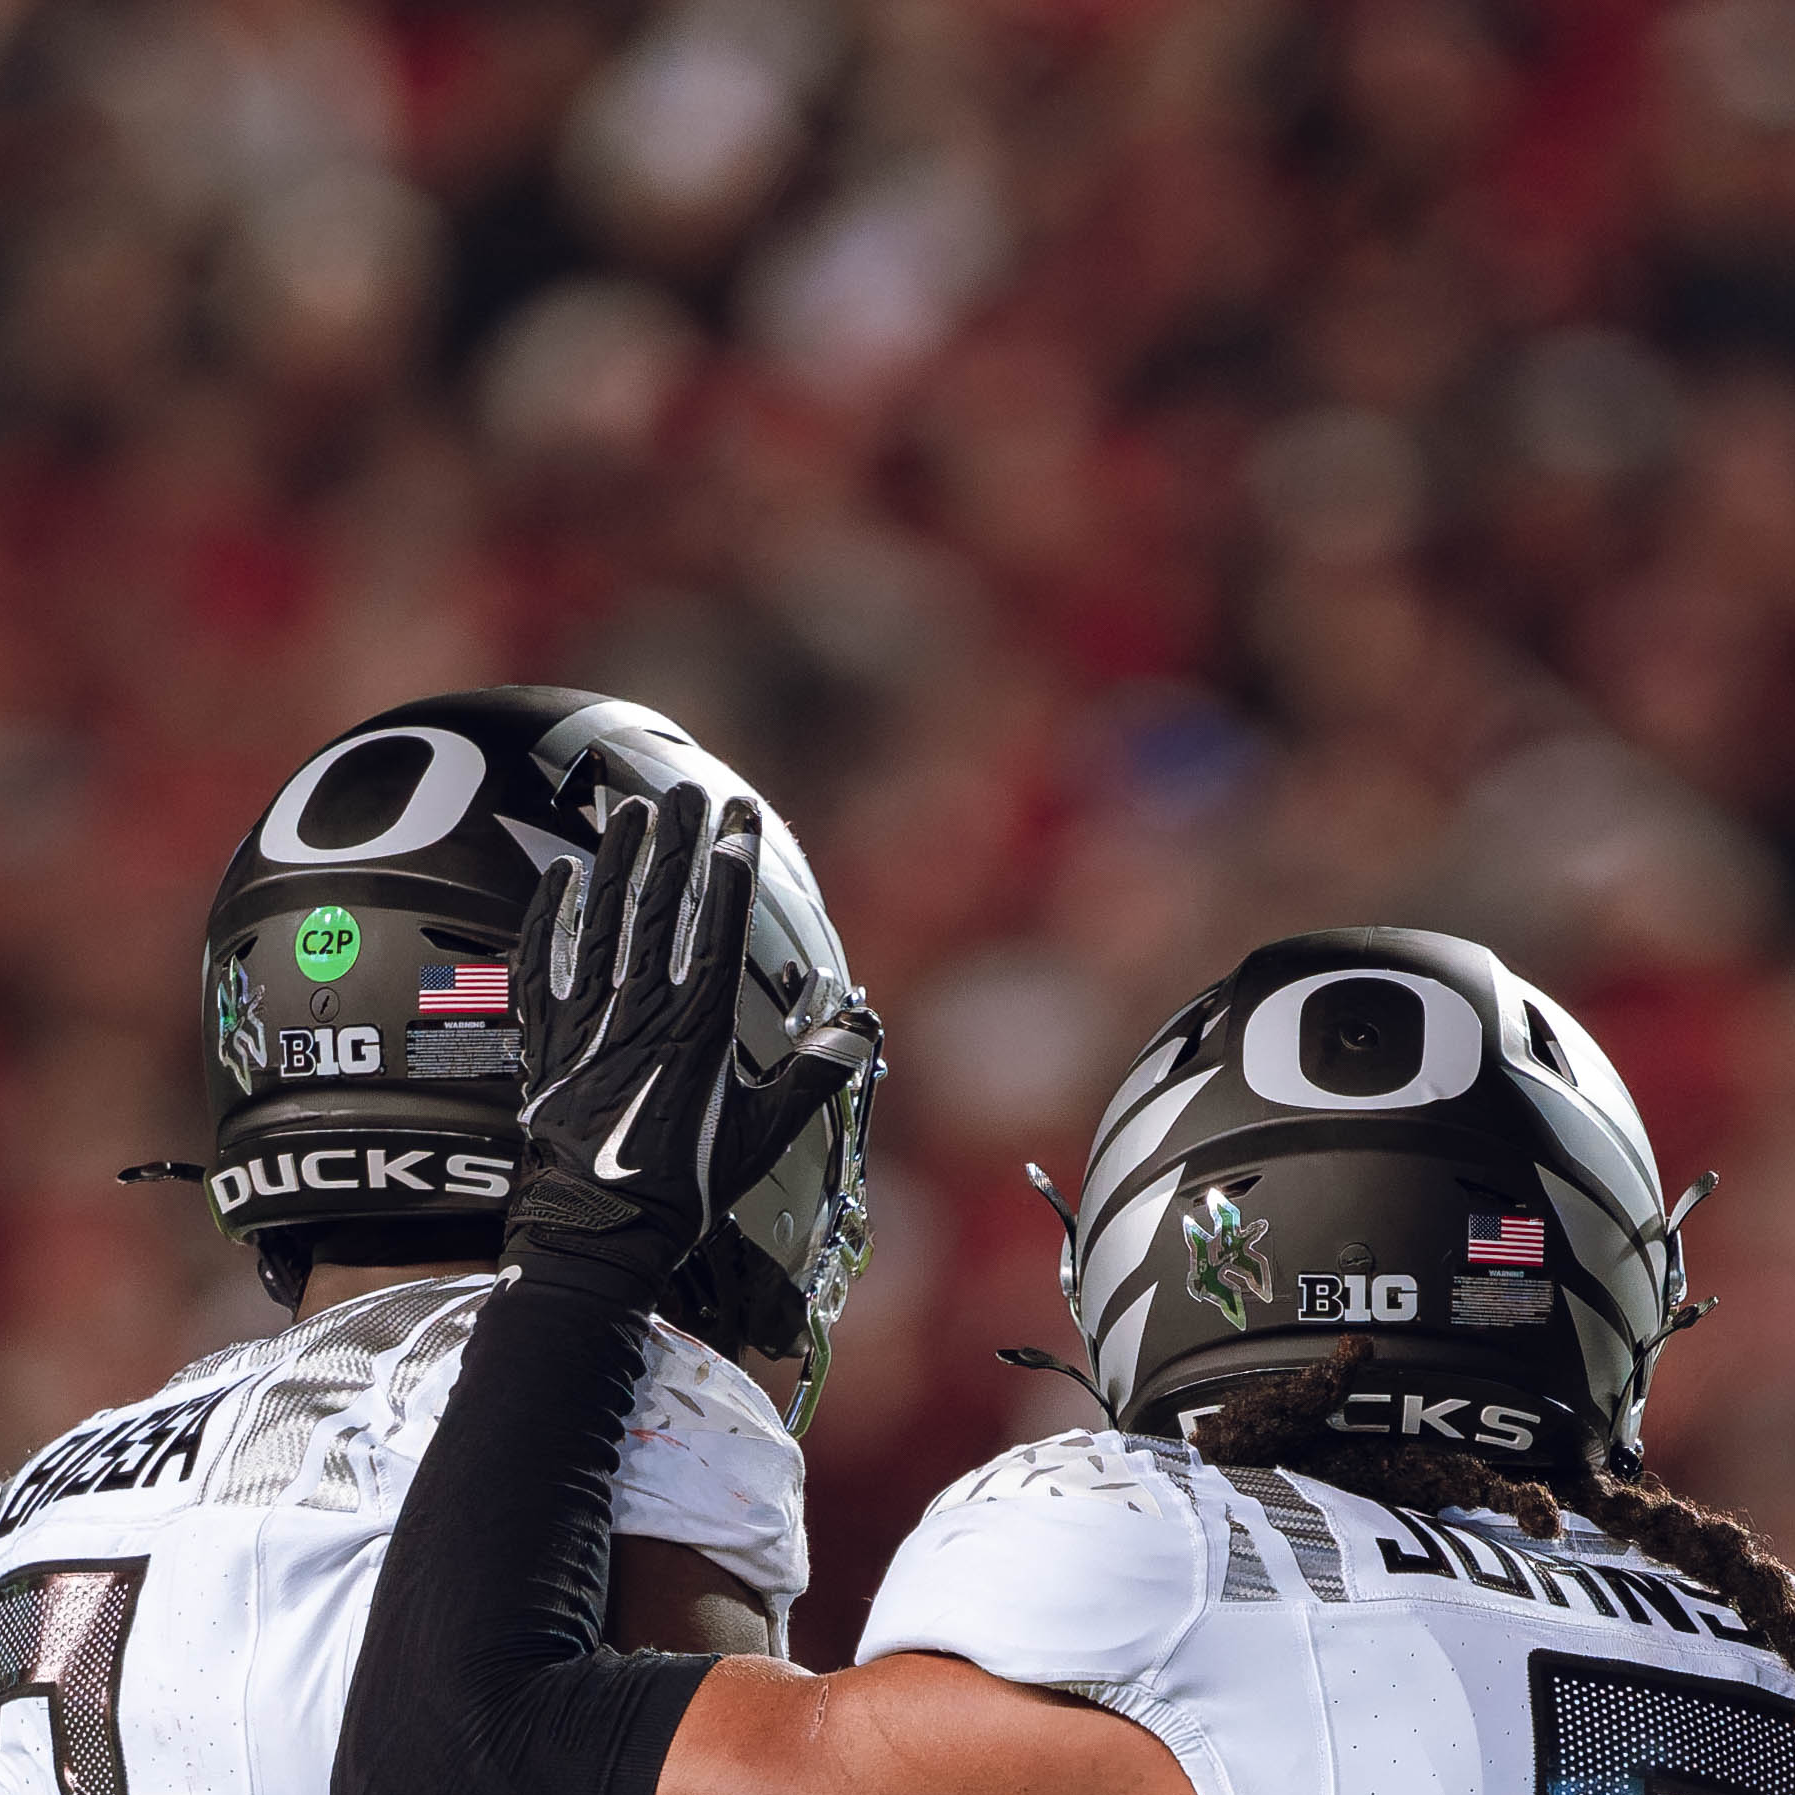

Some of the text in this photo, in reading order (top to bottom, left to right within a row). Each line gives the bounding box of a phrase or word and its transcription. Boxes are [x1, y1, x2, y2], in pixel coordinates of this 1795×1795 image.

[259, 726, 486, 864] O
[301, 928, 354, 957] C2P
[444, 1021, 486, 1029] WARNING
[1243, 969, 1482, 1110] O
[211, 1149, 515, 1214] DUCKS
[1488, 1269, 1525, 1278] WARNING
